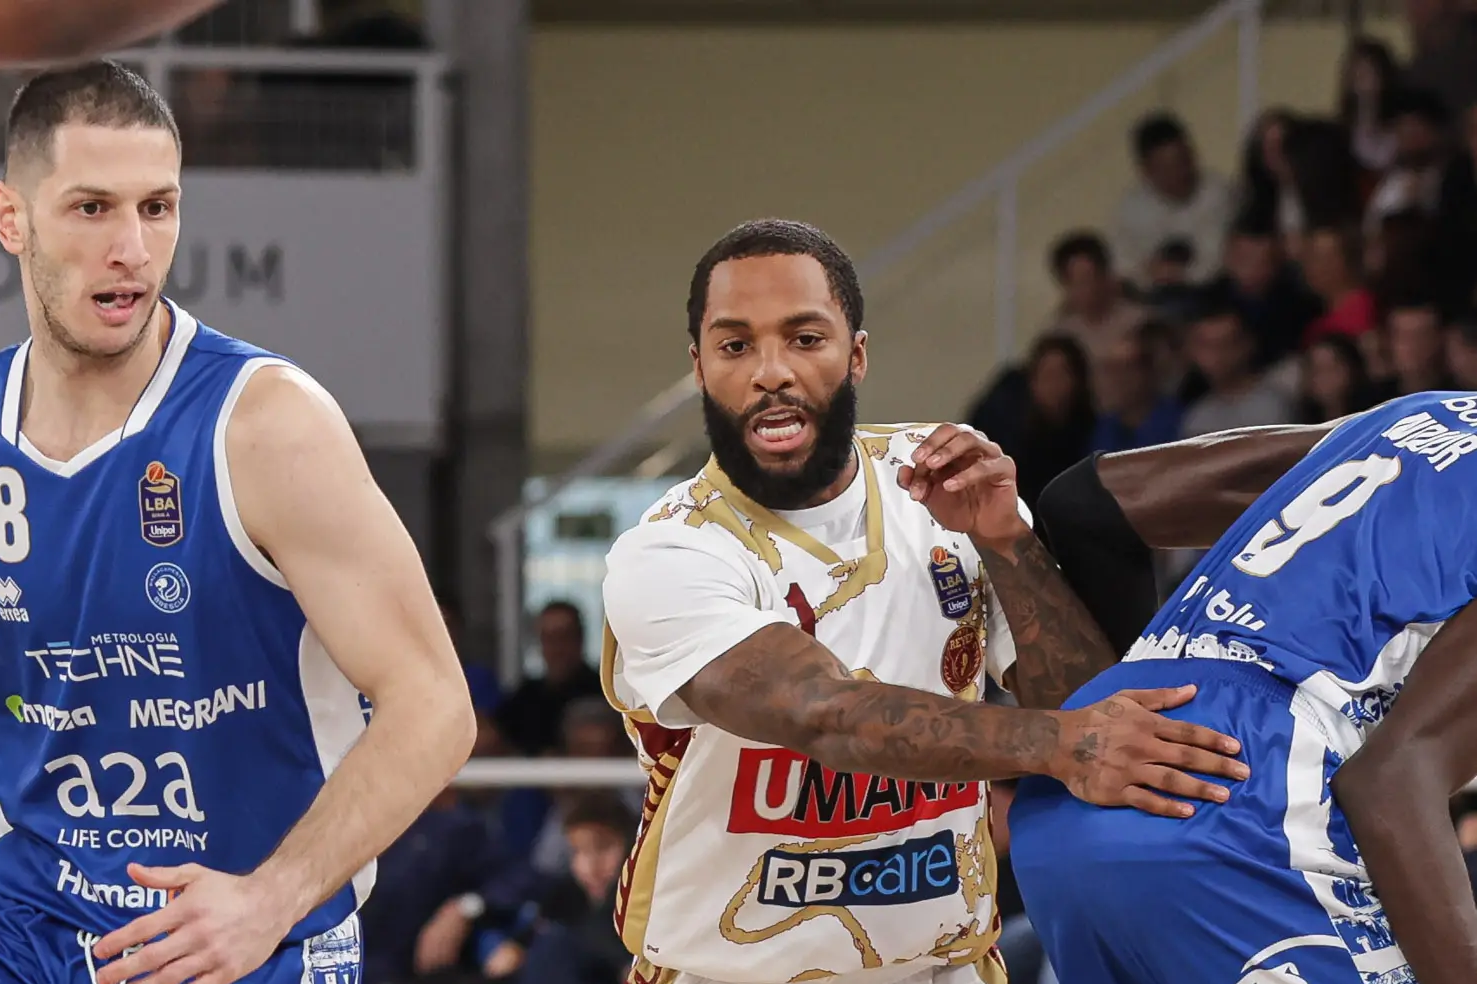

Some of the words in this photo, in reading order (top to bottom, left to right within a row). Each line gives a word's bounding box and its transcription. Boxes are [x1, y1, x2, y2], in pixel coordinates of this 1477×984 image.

[145, 497, 176, 512] LBA
[1231, 452, 1402, 578] 9
[150, 524, 176, 537] Unipol
[938, 573, 964, 591] LBA
[948, 597, 969, 612] Unipol
[91, 632, 178, 645] METROLOGIA
[25, 641, 185, 682] TECHNE
[130, 680, 267, 731] MEGRANI
[44, 751, 206, 822] a2a
[57, 828, 101, 848] LIFE
[107, 828, 208, 852] COMPANY
[56, 859, 180, 908] Human
[763, 844, 952, 903] RBcare
